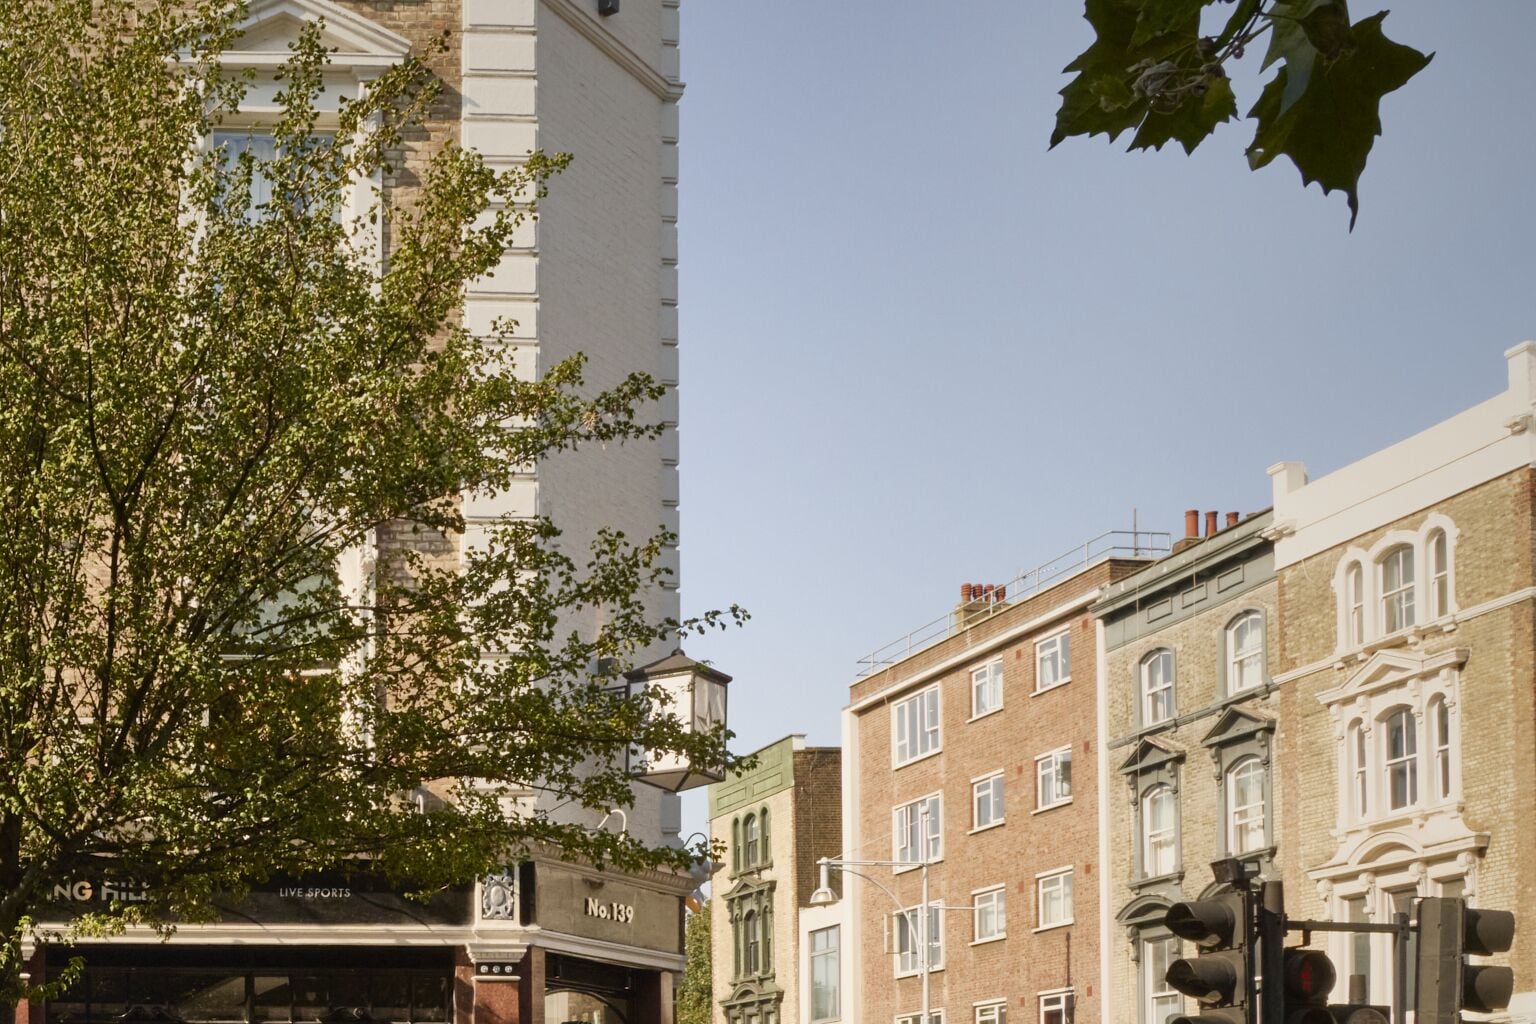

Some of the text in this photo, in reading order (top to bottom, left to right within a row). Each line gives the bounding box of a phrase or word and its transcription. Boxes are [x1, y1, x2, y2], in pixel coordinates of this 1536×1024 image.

[279, 887, 351, 898] LIVE SPORTS
[587, 897, 634, 924] No.139
